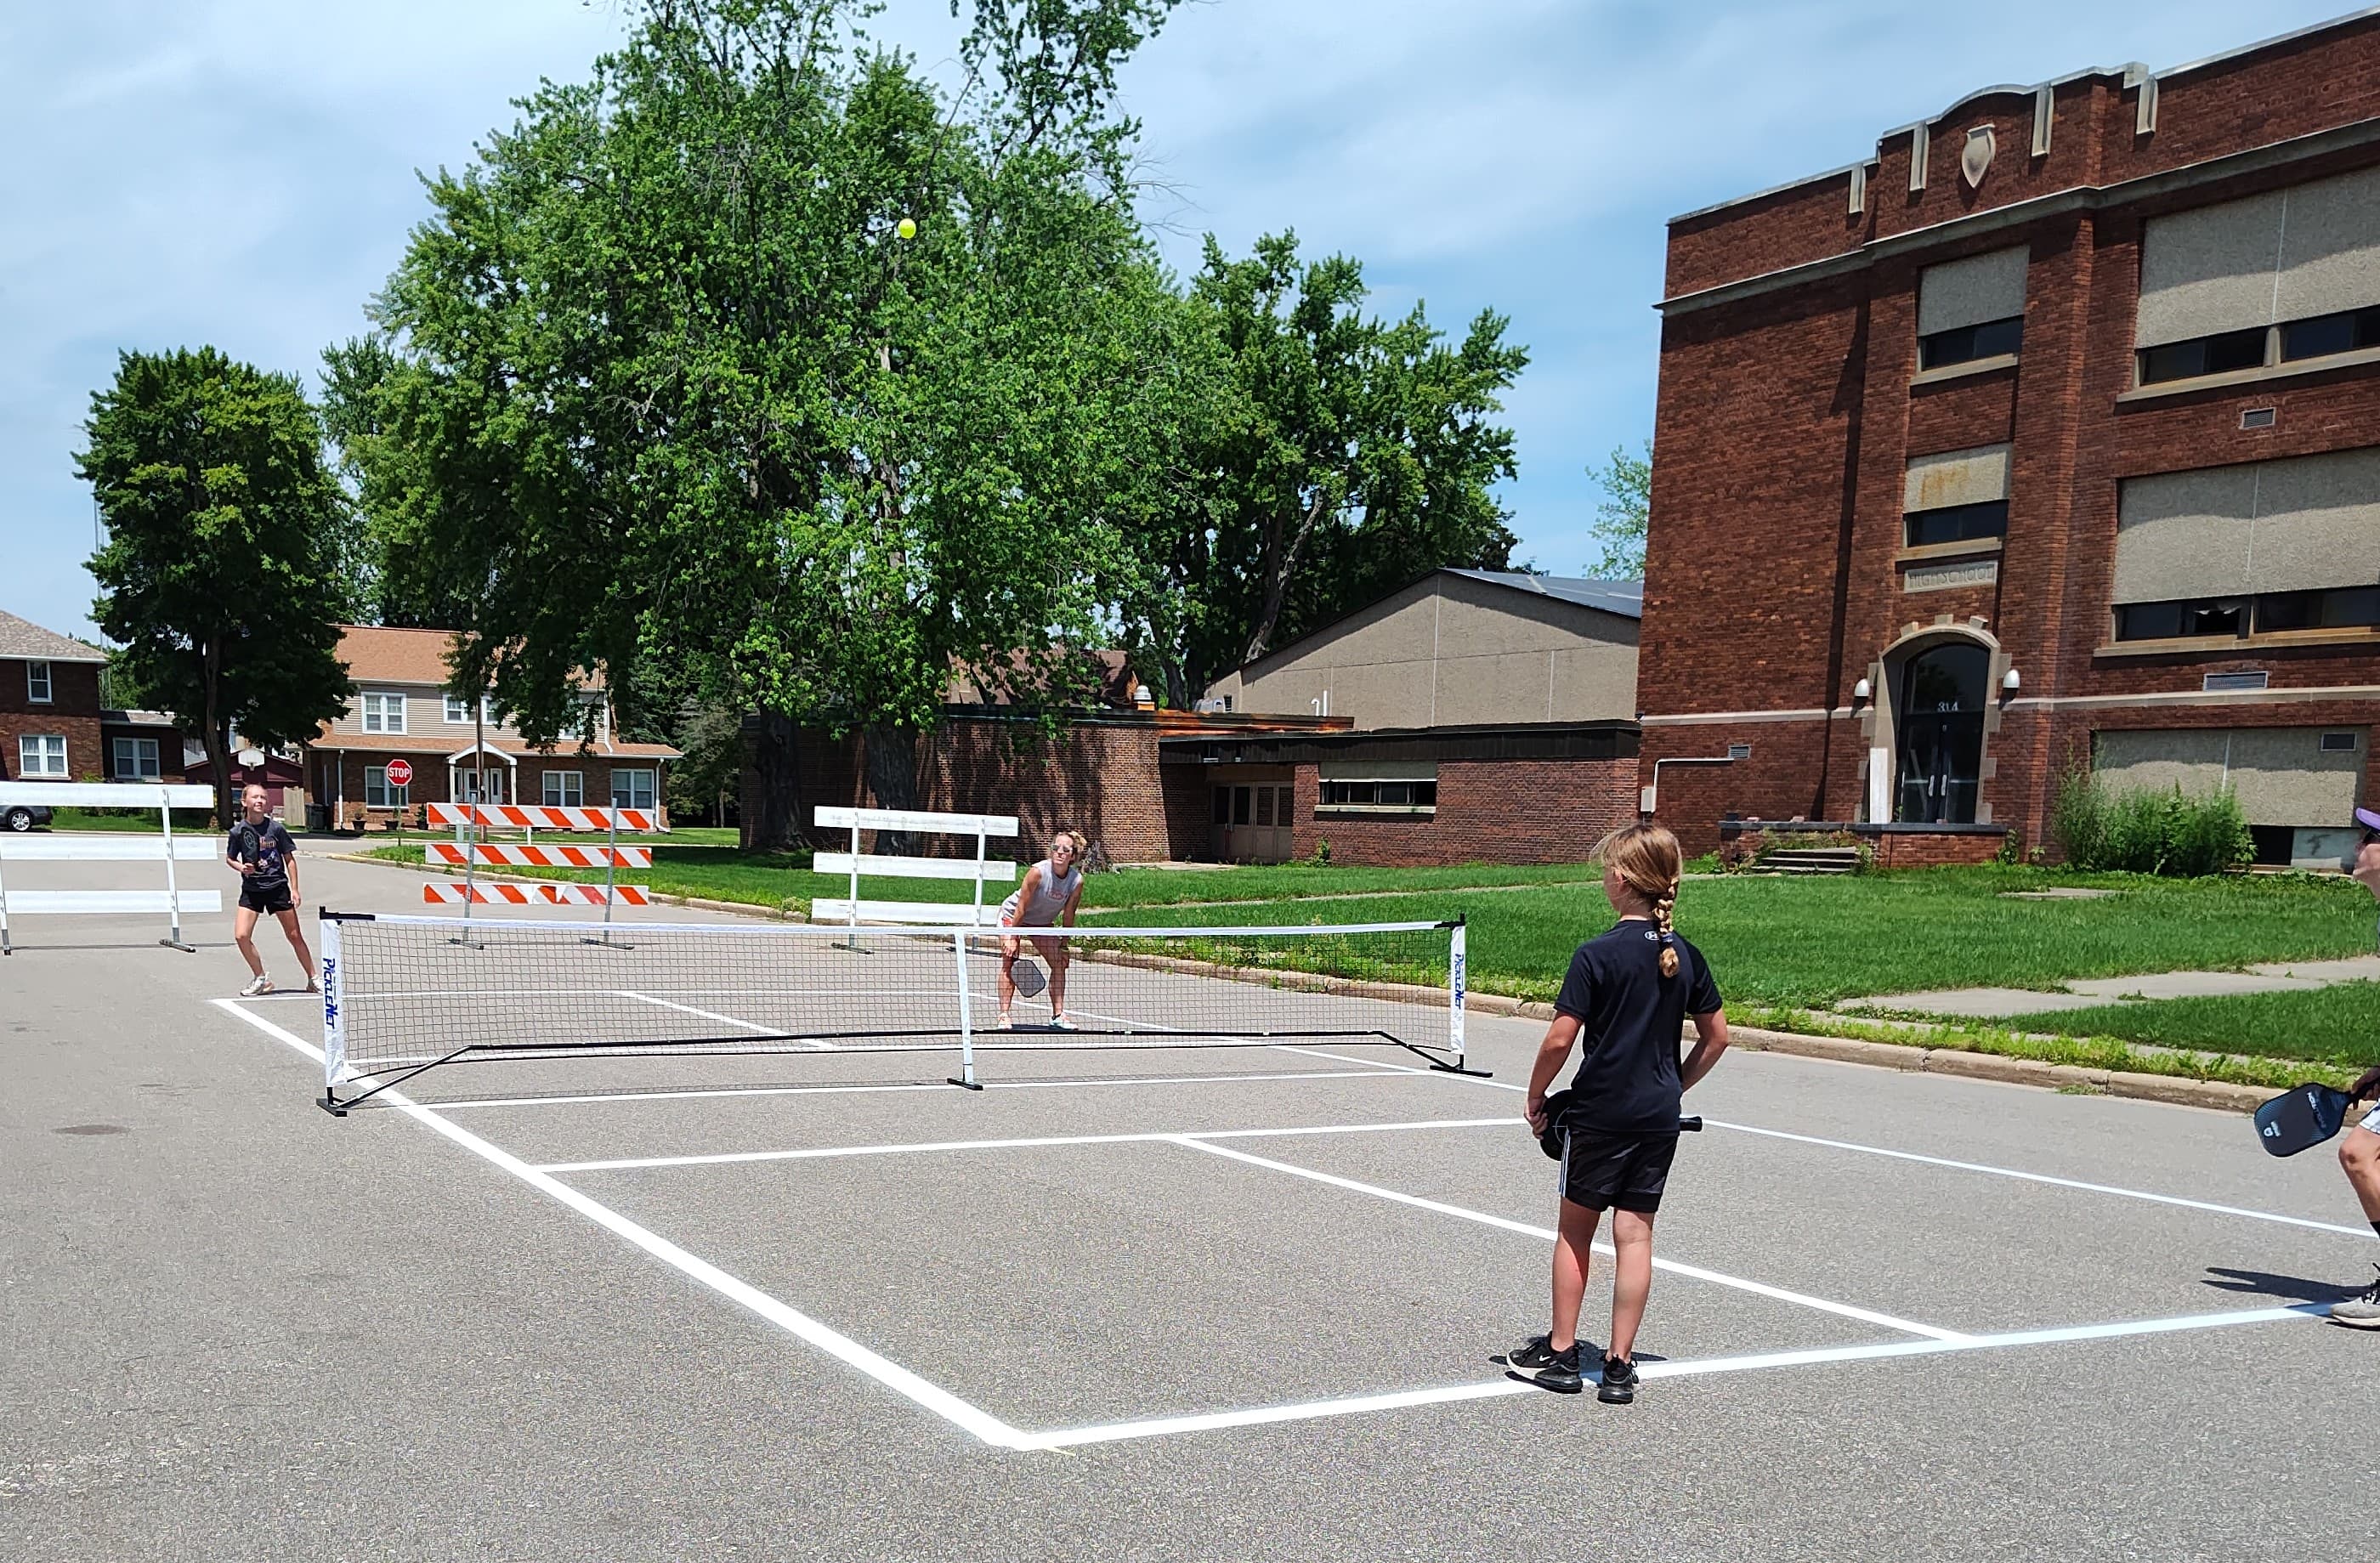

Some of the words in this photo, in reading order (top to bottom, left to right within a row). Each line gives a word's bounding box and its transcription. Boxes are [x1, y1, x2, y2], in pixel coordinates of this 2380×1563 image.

[1939, 564, 1994, 585] SCHOOL
[1938, 701, 1958, 712] 314
[388, 767, 410, 778] STOP
